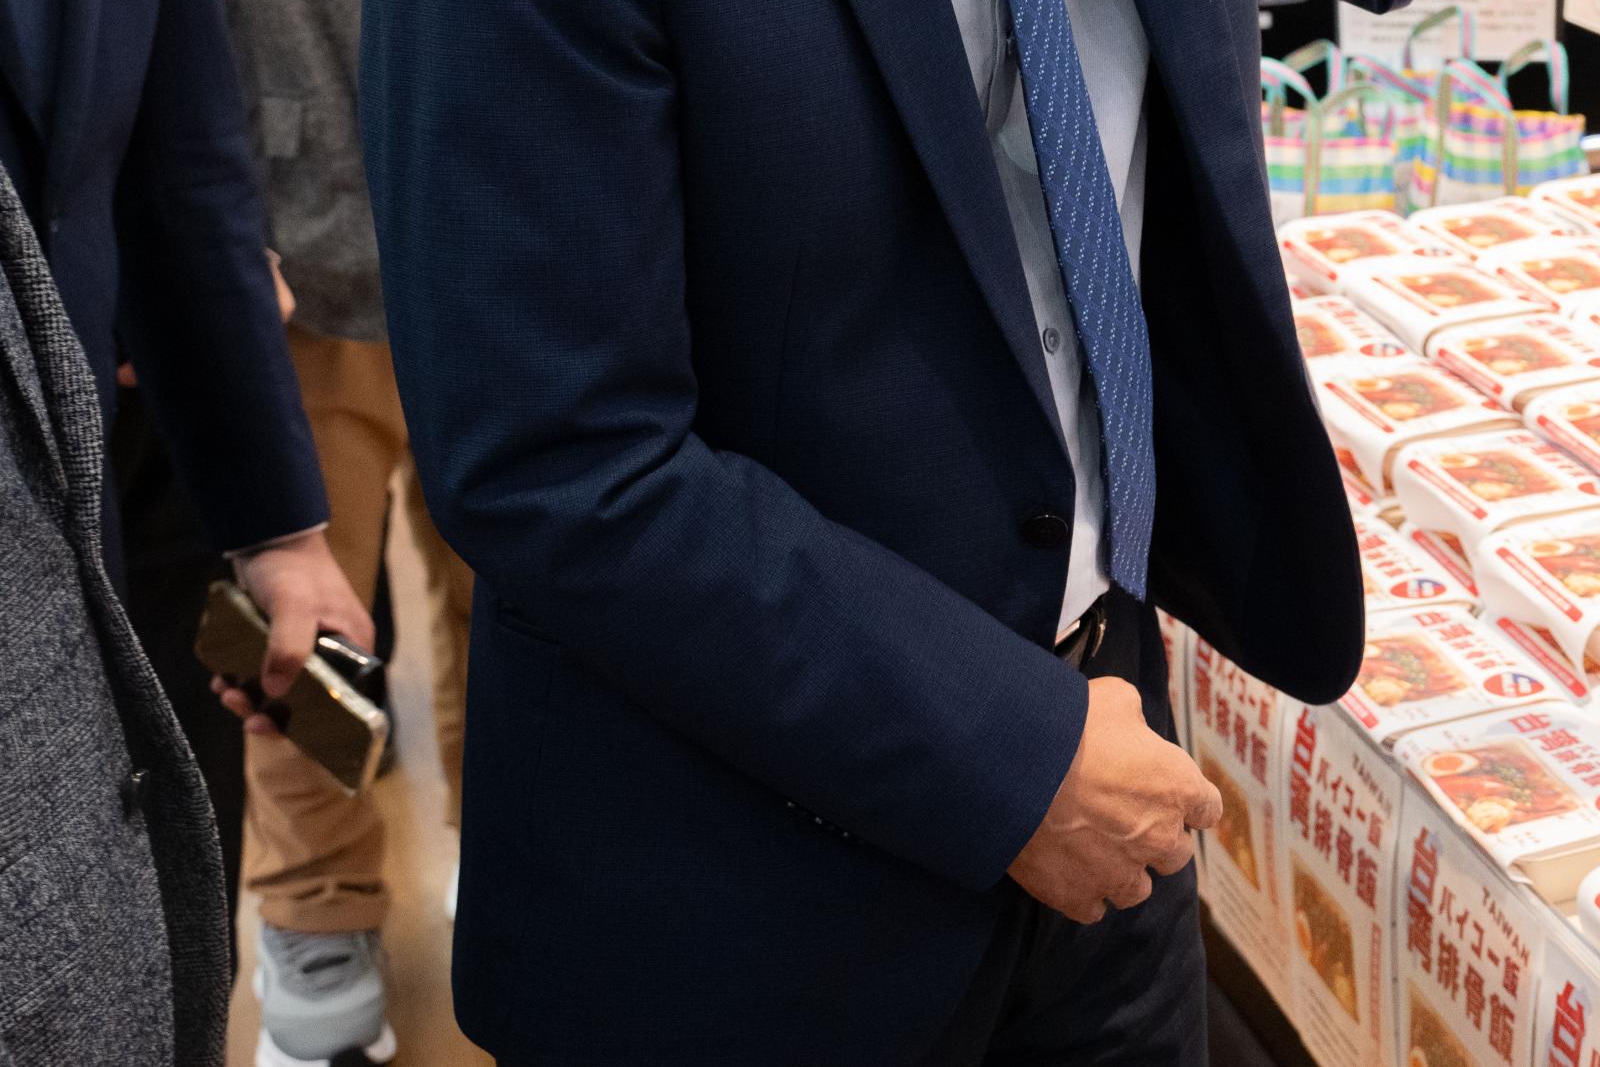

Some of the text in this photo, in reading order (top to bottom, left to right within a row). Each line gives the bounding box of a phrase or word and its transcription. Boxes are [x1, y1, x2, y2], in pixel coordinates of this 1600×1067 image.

[1407, 825, 1438, 974] 台湾
[1482, 885, 1531, 968] TAIWAN
[1436, 931, 1516, 1066] 排骨飯
